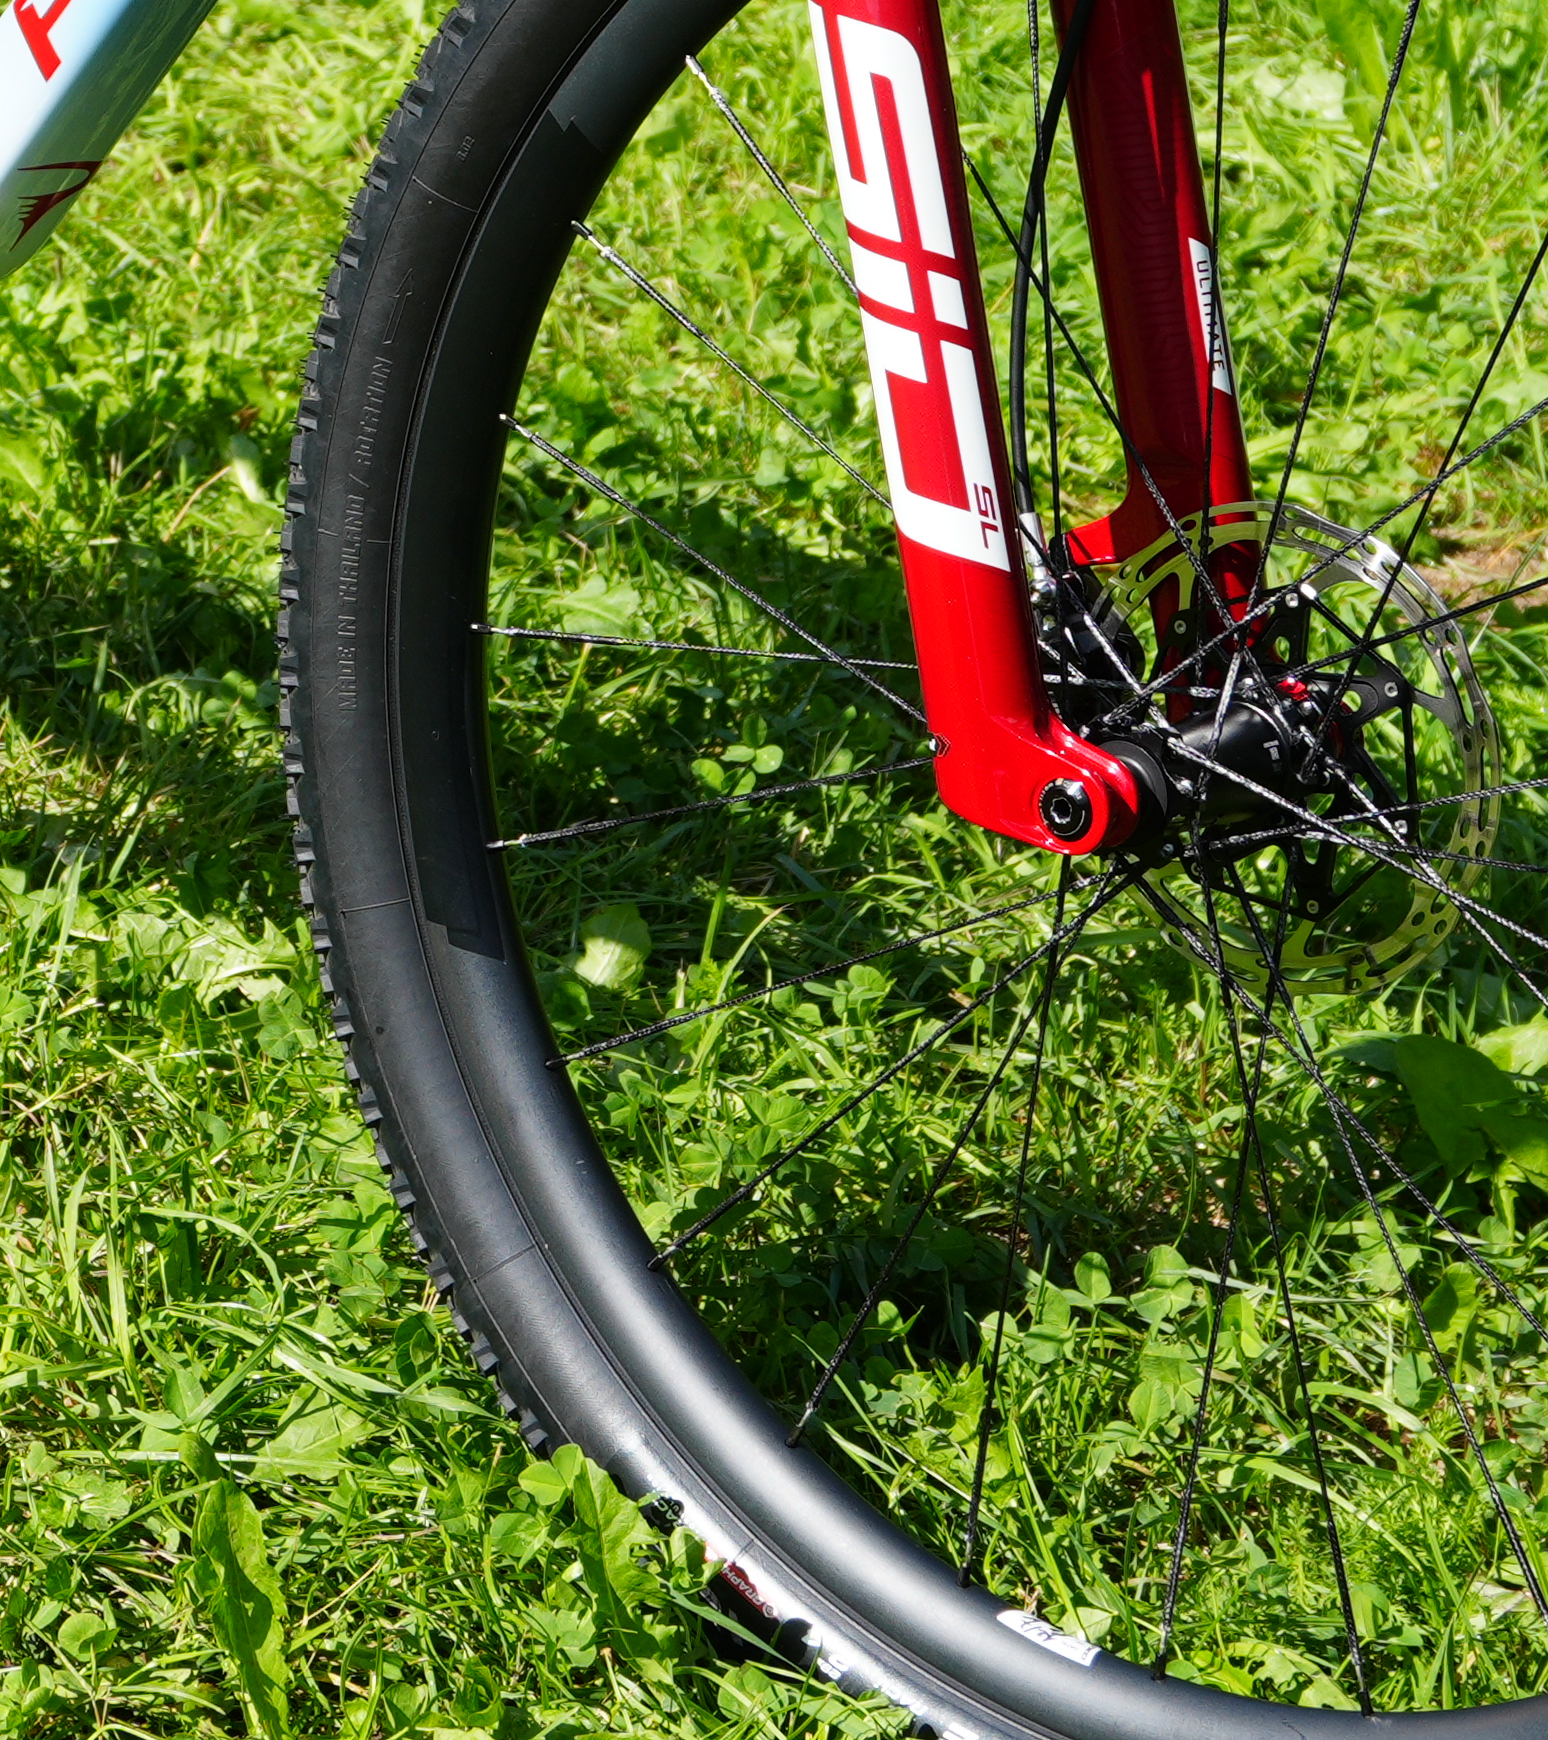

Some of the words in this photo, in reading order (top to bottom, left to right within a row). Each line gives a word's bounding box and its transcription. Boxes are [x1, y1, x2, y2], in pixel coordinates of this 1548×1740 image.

[357, 356, 395, 467] ROTATION
[338, 494, 367, 607] THAILAND
[972, 482, 1003, 551] SL
[337, 614, 358, 640] IN
[337, 646, 358, 713] MADE
